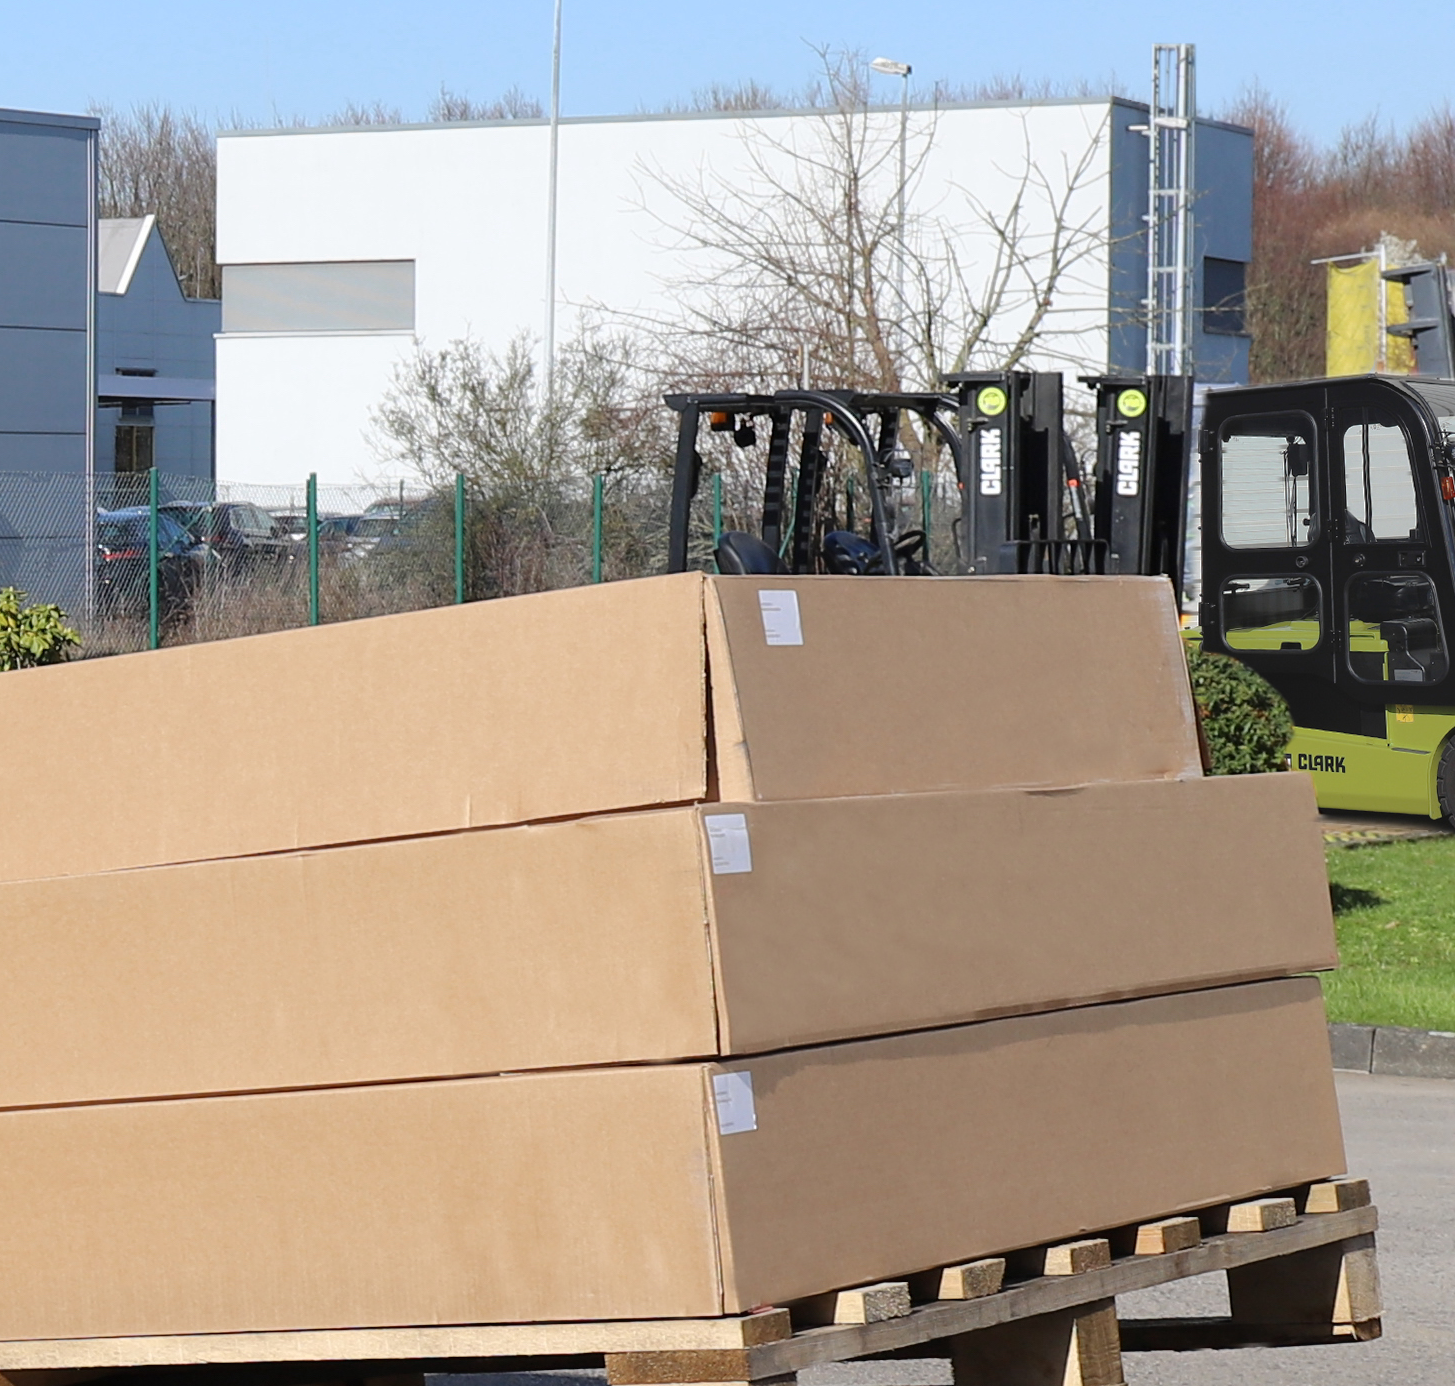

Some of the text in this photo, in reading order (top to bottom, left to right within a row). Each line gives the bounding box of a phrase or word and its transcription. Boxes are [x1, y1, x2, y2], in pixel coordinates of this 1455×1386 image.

[980, 428, 1002, 496] CLARK
[1117, 431, 1141, 496] CLARK
[1298, 753, 1346, 773] CLARK
